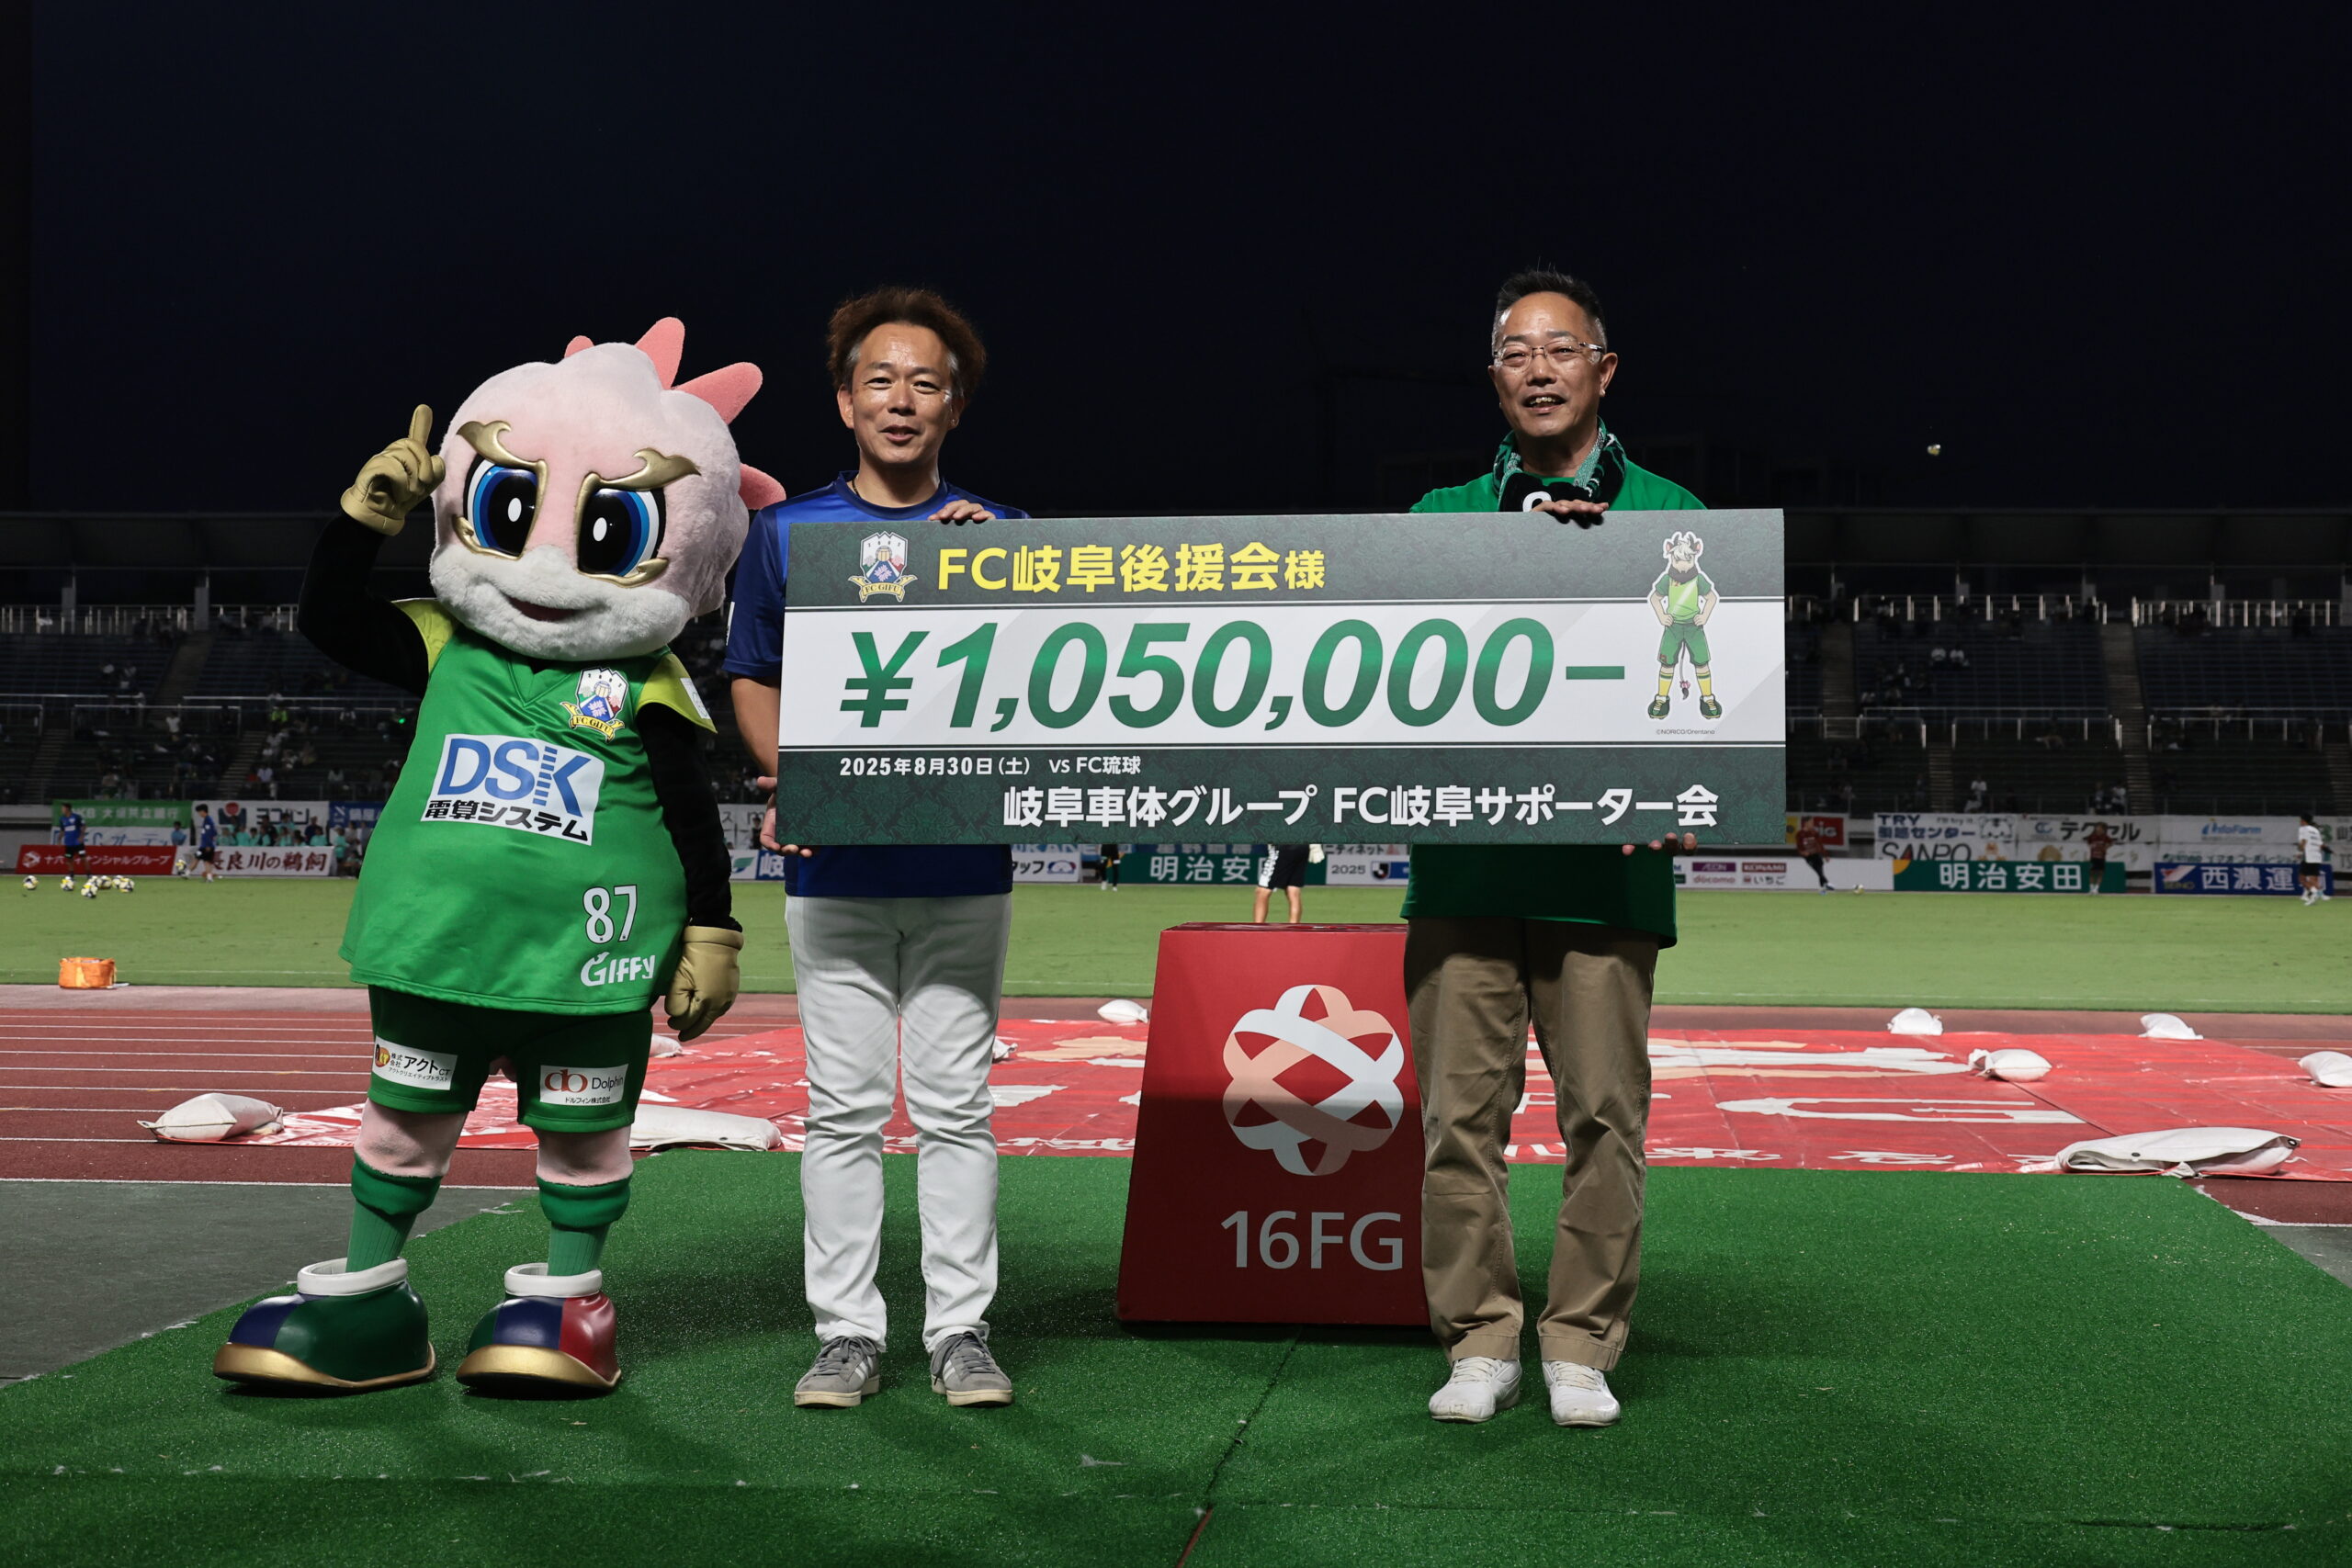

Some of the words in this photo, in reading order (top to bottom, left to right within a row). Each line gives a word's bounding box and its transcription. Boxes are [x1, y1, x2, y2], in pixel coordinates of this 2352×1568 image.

[938, 542, 1326, 593] FC岐阜後援会様
[1076, 756, 1141, 774] FC琉球
[437, 738, 591, 818] DSK
[1003, 785, 1318, 828] 岐阜車体グループ
[1334, 784, 1719, 827] FC岐阜サポーター会
[425, 799, 589, 842] 電算システム
[1878, 815, 1920, 825] TRY
[1878, 827, 1975, 840] センター
[44, 854, 171, 866] 十六ィナンシャルグループ
[1149, 855, 1269, 882] 明治安
[1331, 864, 1366, 874] 2025
[1744, 863, 1786, 872] KONAMI
[1693, 873, 1736, 884] docomo
[1939, 863, 2082, 890] 明治安田
[2200, 866, 2325, 891] 西濃運
[582, 885, 639, 944] 87
[404, 1055, 438, 1074] アクト
[438, 1067, 451, 1076] CT
[591, 1076, 624, 1091] Dolphin
[1221, 1210, 1403, 1270] 16FG
